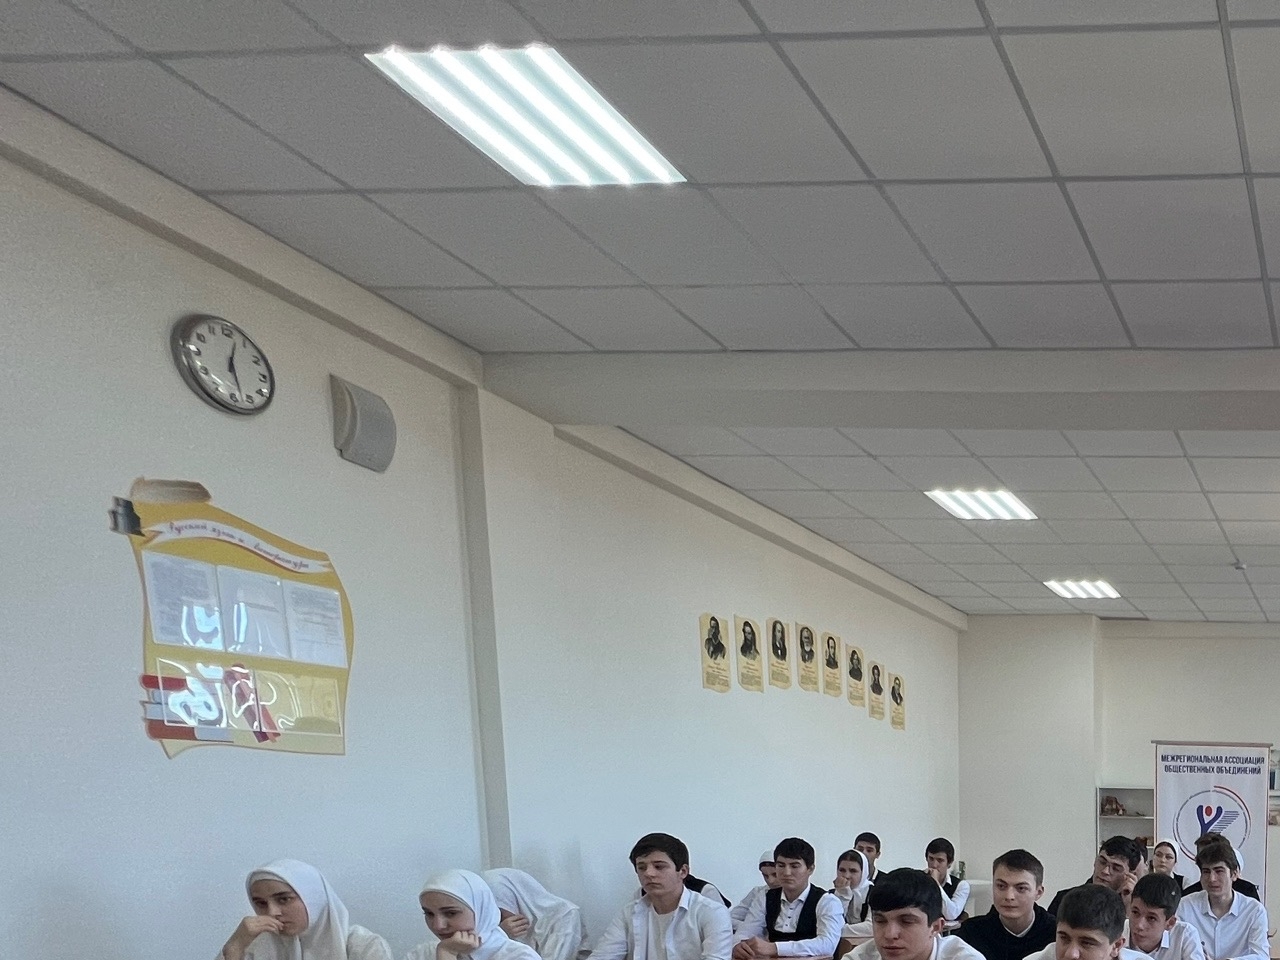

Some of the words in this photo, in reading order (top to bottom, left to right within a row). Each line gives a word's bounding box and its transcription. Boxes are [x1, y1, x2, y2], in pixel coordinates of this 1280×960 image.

[1161, 755, 1223, 764] МЕЖРЕГИОНАЛЬНАЯ
[1224, 757, 1265, 765] АССОЦИАЦИЯ
[1164, 765, 1215, 774] ОБЩЕСТВЕННЫХ
[1216, 766, 1261, 775] ОБЪЕДИНЕНИЙ
